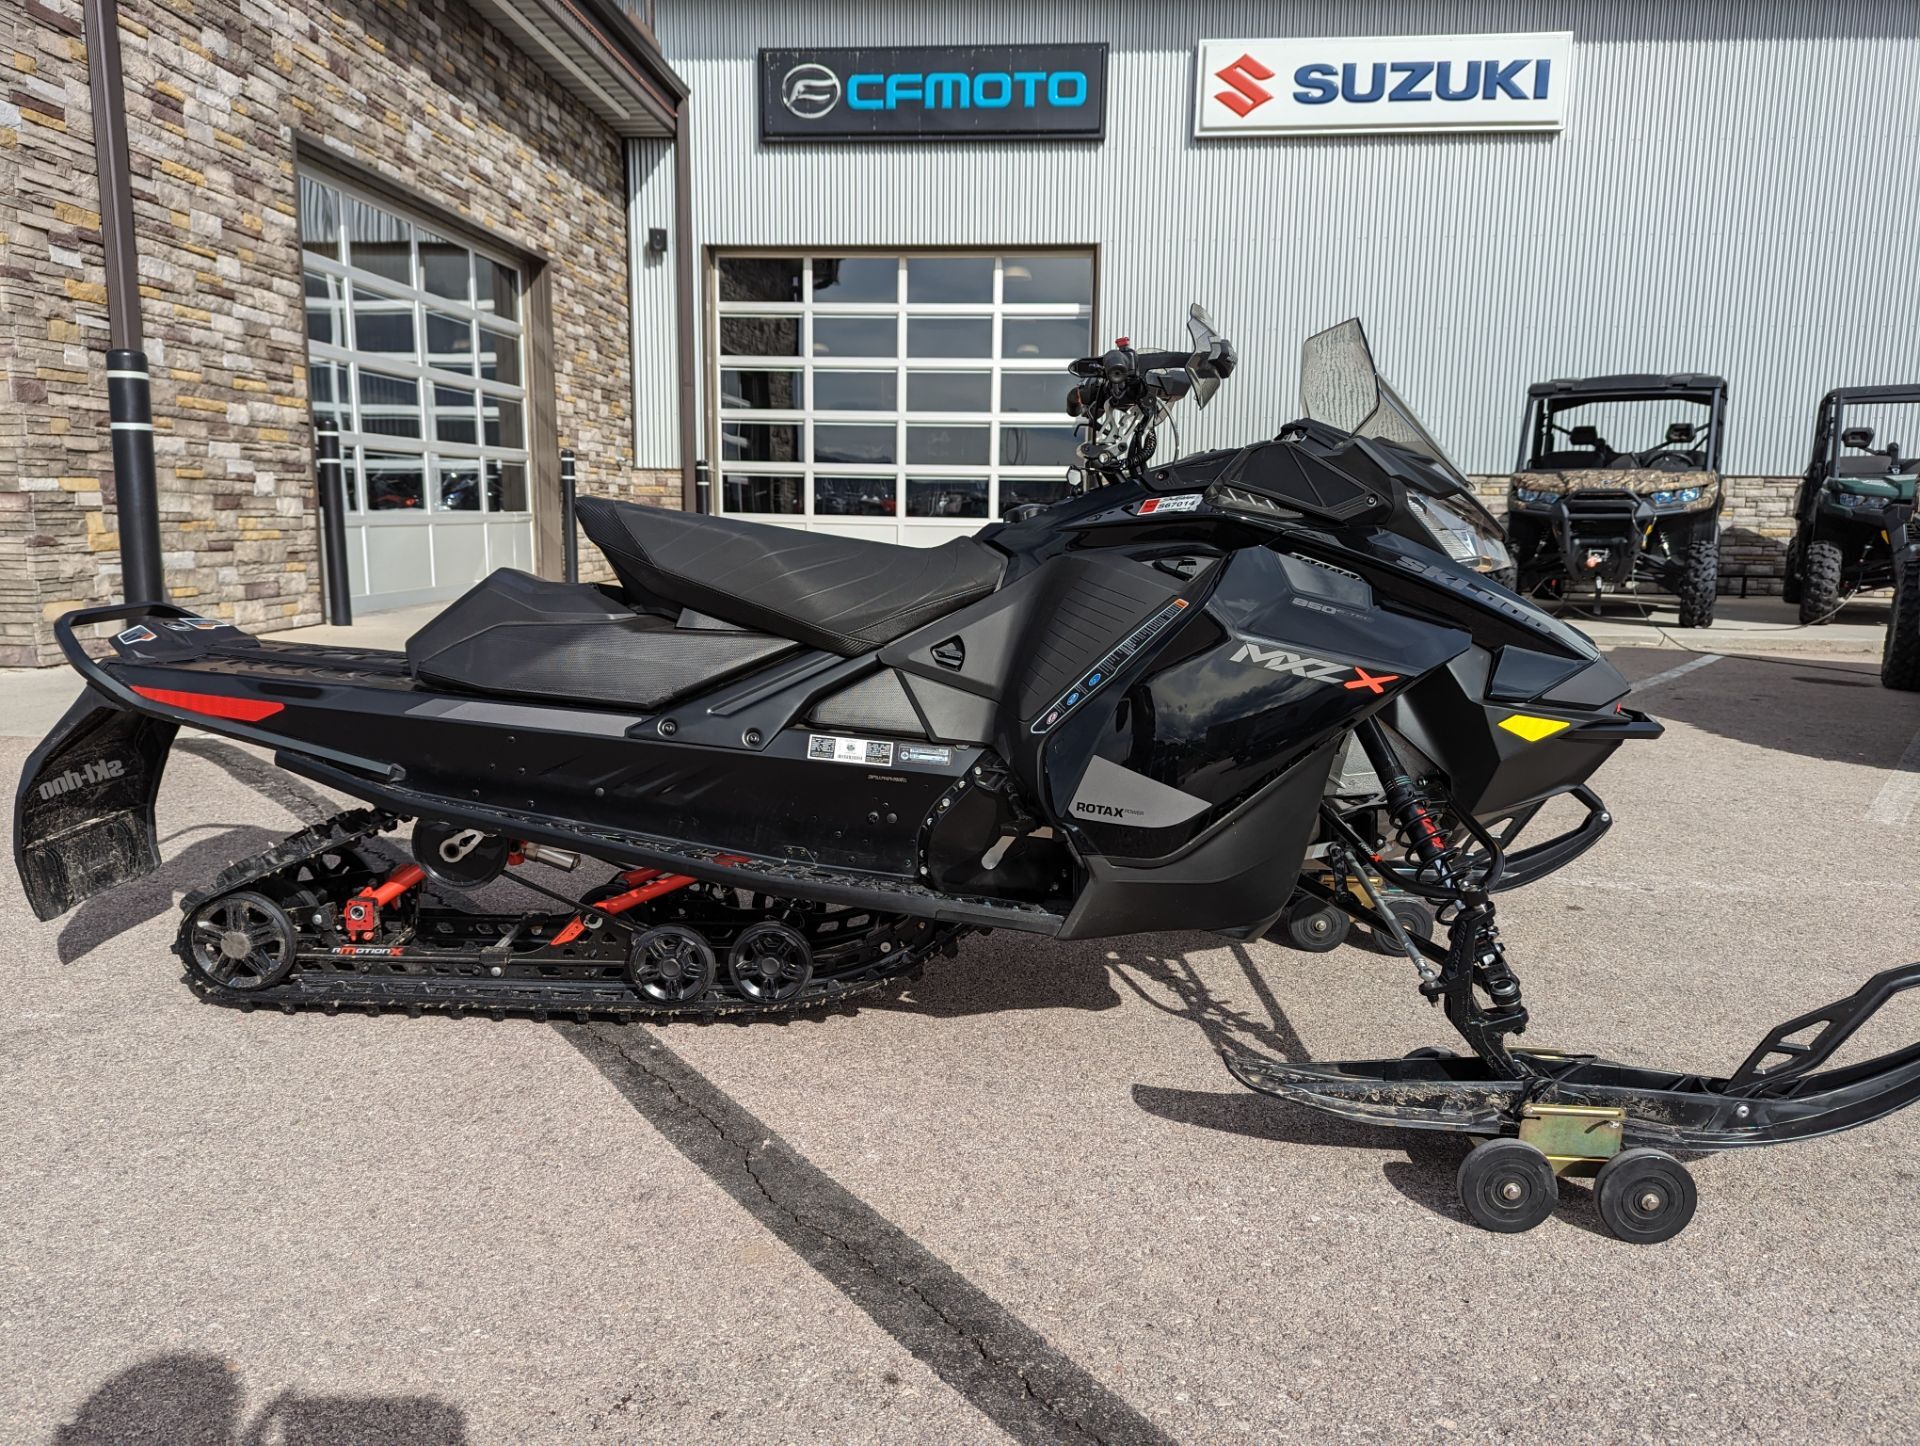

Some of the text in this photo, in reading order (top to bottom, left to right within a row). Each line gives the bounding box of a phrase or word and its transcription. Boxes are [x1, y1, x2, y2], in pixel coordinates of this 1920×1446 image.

[846, 70, 1088, 110] CFMOTO
[1292, 58, 1551, 105] SUZUKI
[1228, 642, 1352, 684] MXZ
[1076, 801, 1124, 818] ROTAX
